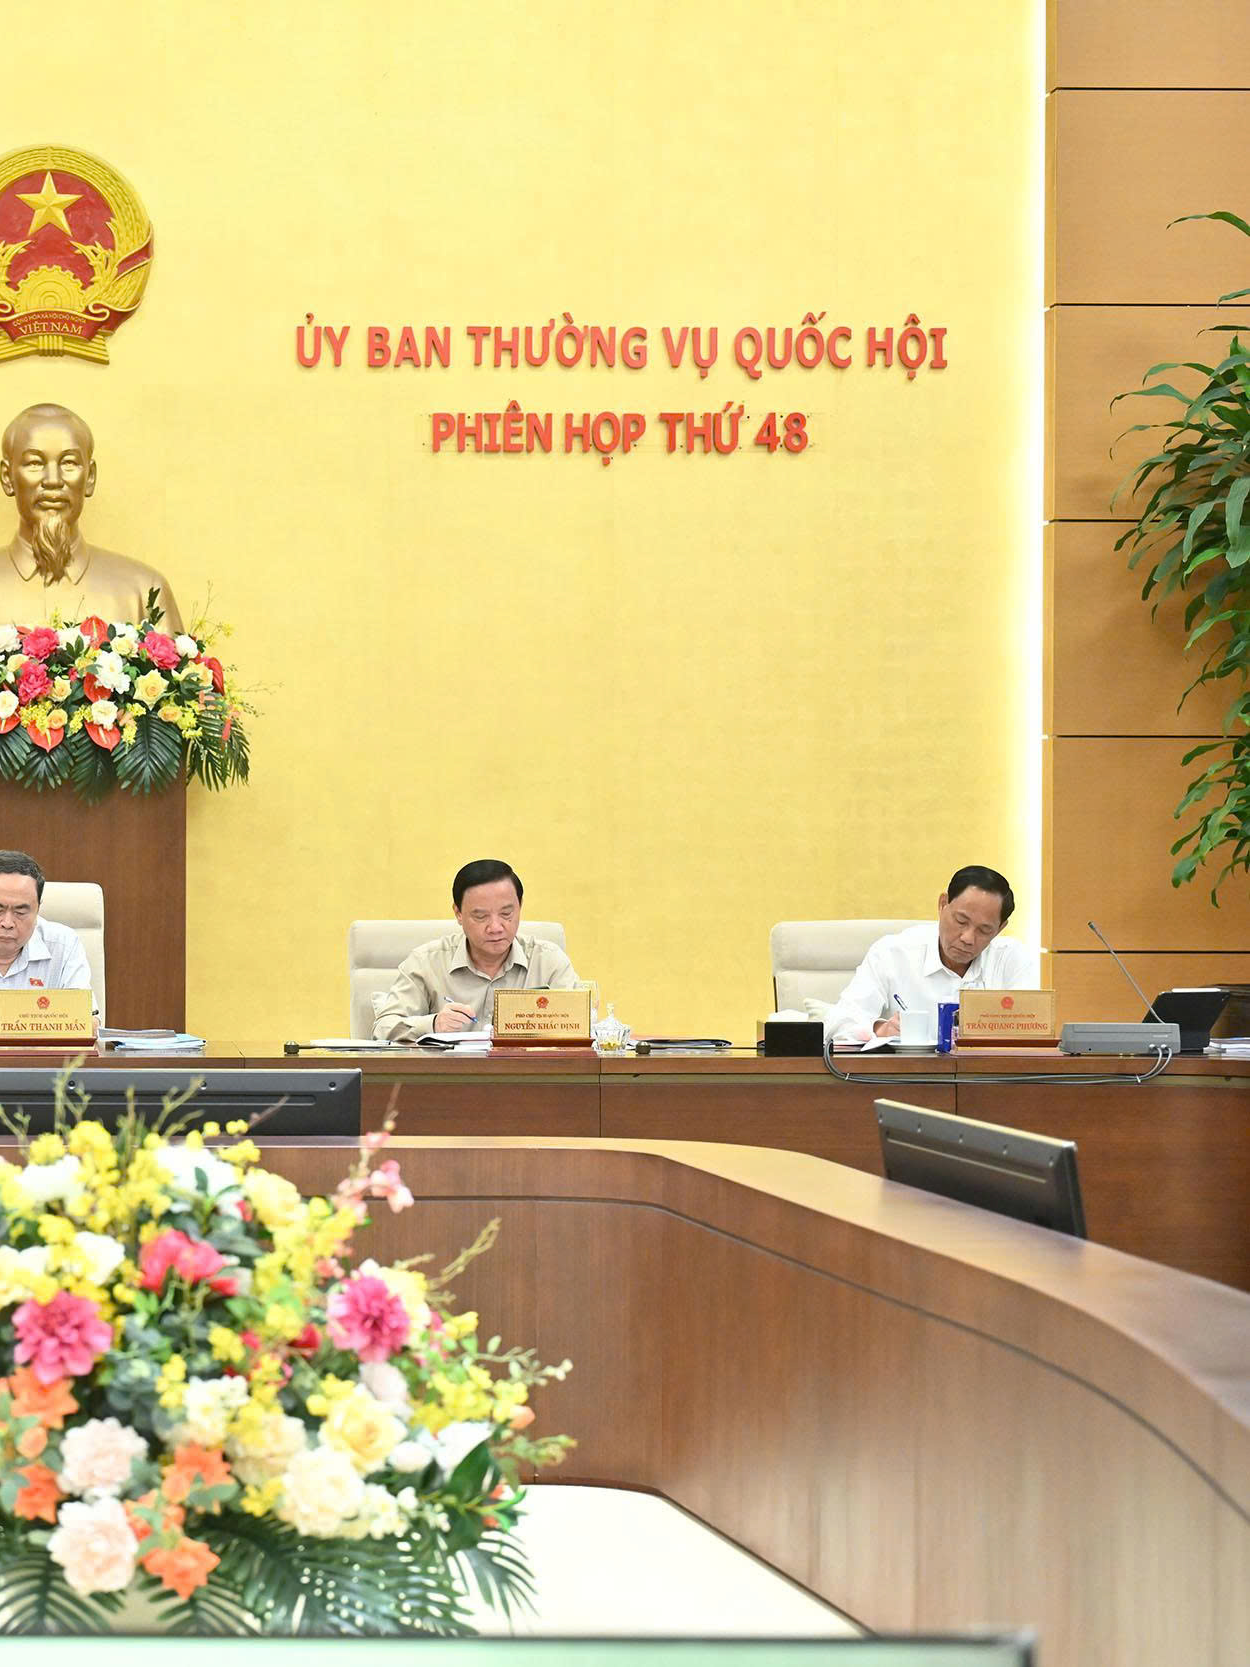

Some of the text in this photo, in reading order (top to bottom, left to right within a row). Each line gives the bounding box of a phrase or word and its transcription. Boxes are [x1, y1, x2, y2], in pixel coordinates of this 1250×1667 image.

[50, 322, 84, 335] NAM
[295, 311, 948, 379] ỦY BAN THƯỜNG VỤ QUỐC HỘI
[431, 399, 810, 465] PHIÊN HỌP THỨ 48
[29, 1023, 63, 1031] THANH
[988, 1022, 1015, 1031] QUANG
